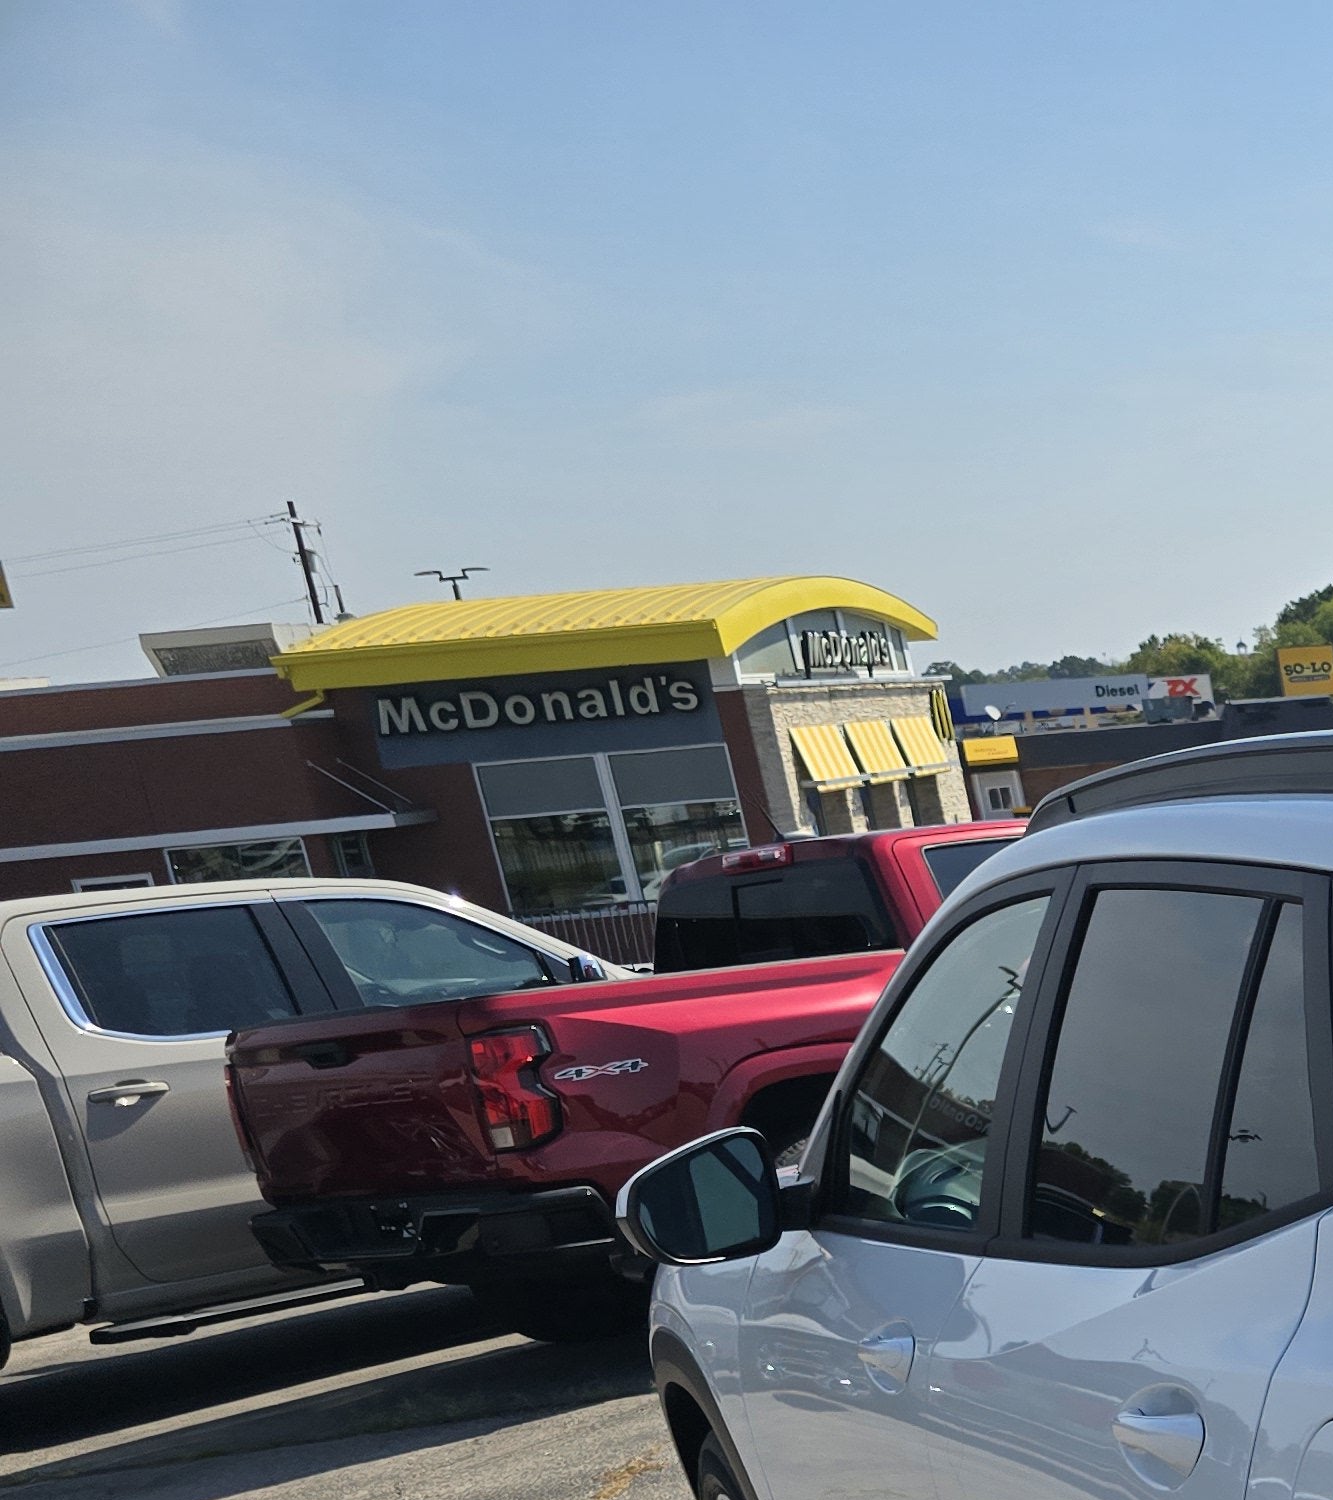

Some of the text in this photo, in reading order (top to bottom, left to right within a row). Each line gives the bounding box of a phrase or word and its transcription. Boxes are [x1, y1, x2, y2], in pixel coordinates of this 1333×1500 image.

[804, 630, 890, 668] McDonald's
[1283, 661, 1332, 676] SO-LO
[1095, 683, 1140, 698] Diesel
[378, 675, 698, 735] McDonald's
